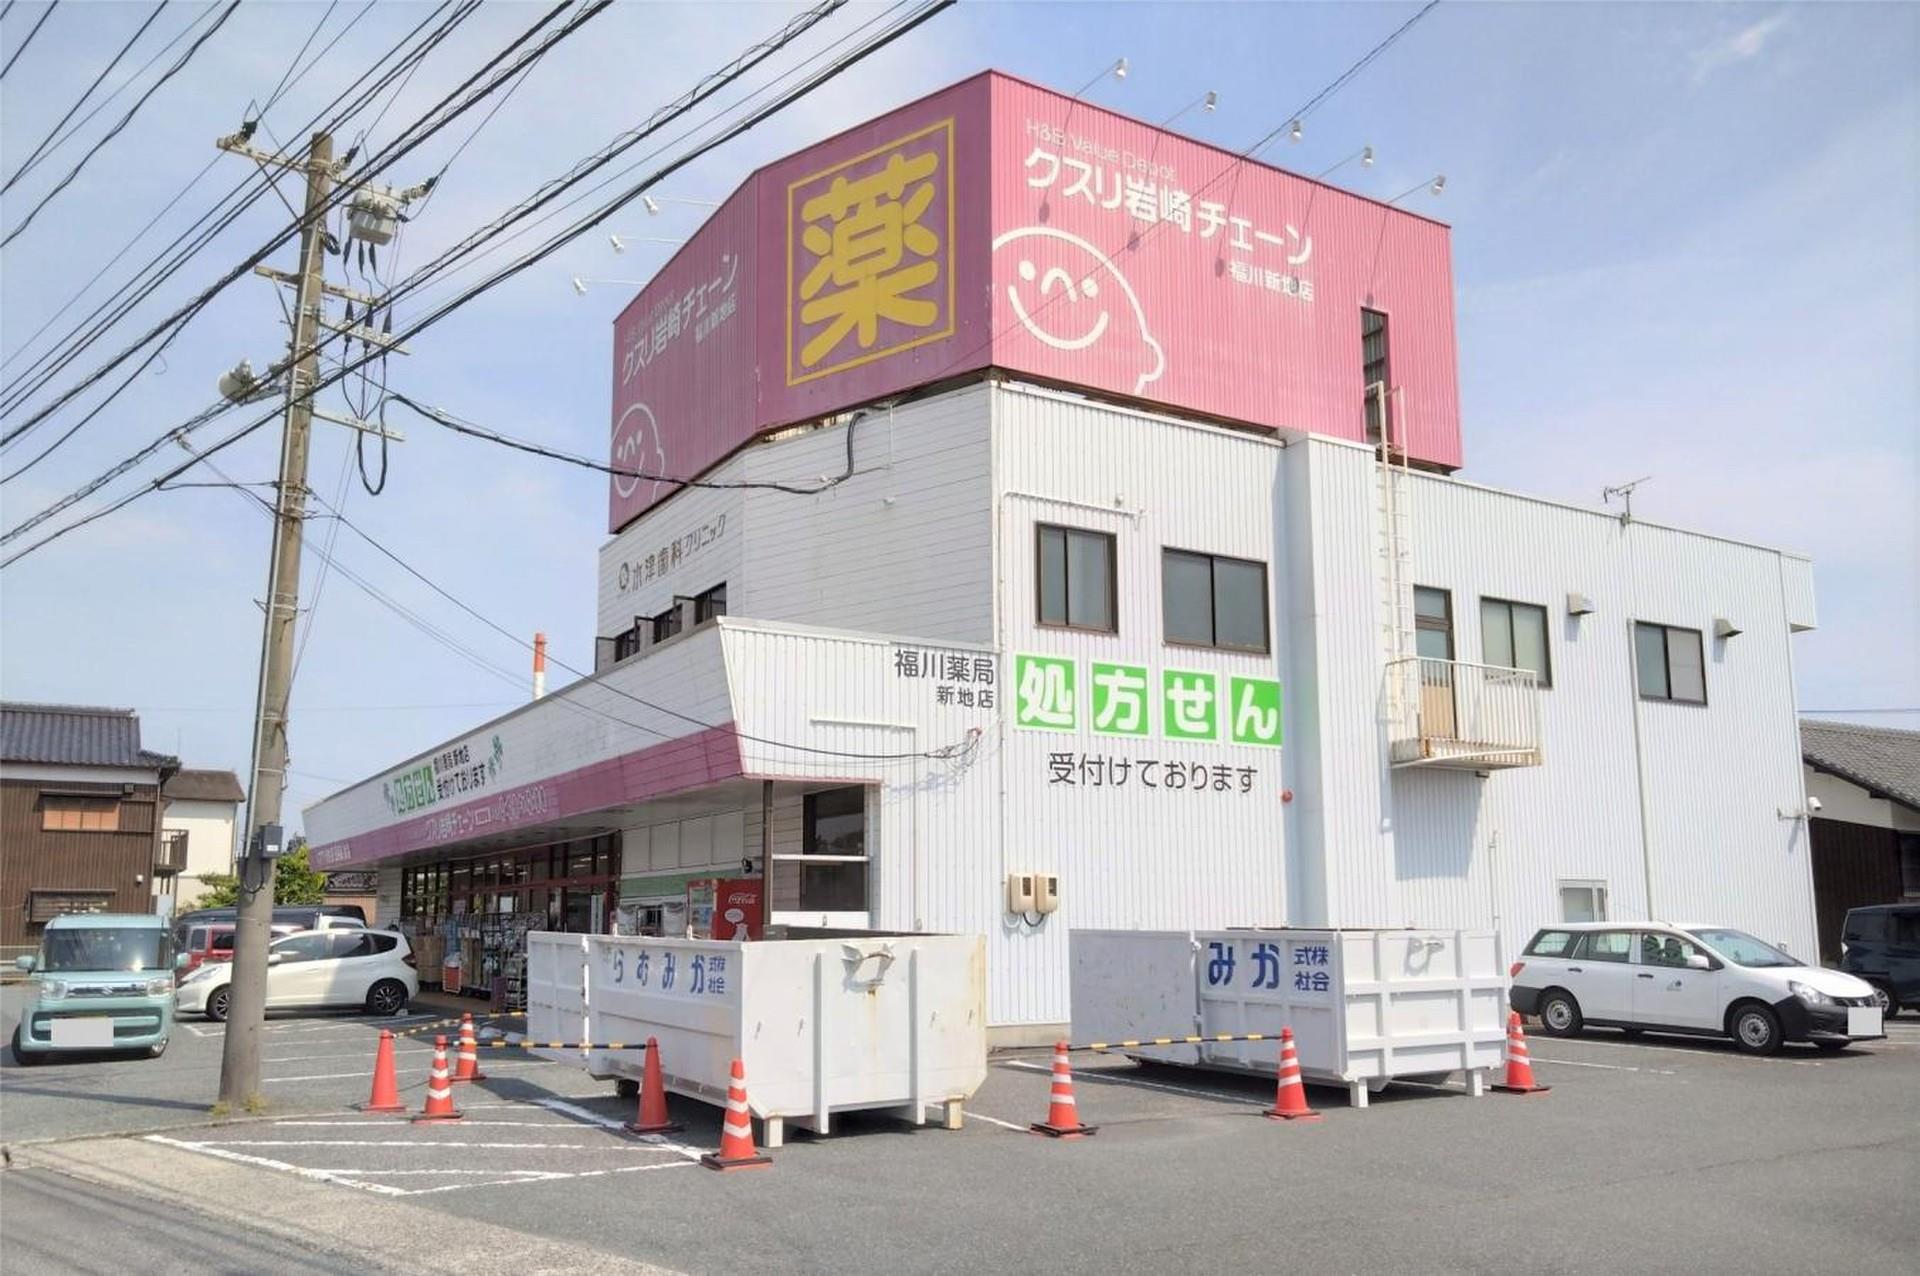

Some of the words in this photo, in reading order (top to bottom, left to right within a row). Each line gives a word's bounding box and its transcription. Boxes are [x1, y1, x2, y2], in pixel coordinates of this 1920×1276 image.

[1025, 147, 1313, 264] クスリ岩崎チェーン
[801, 152, 939, 368] 薬
[894, 648, 995, 686] 福川薬局
[936, 685, 995, 709] 新地店
[1018, 659, 1278, 740] 処方せん
[1049, 753, 1258, 794] 受付けております
